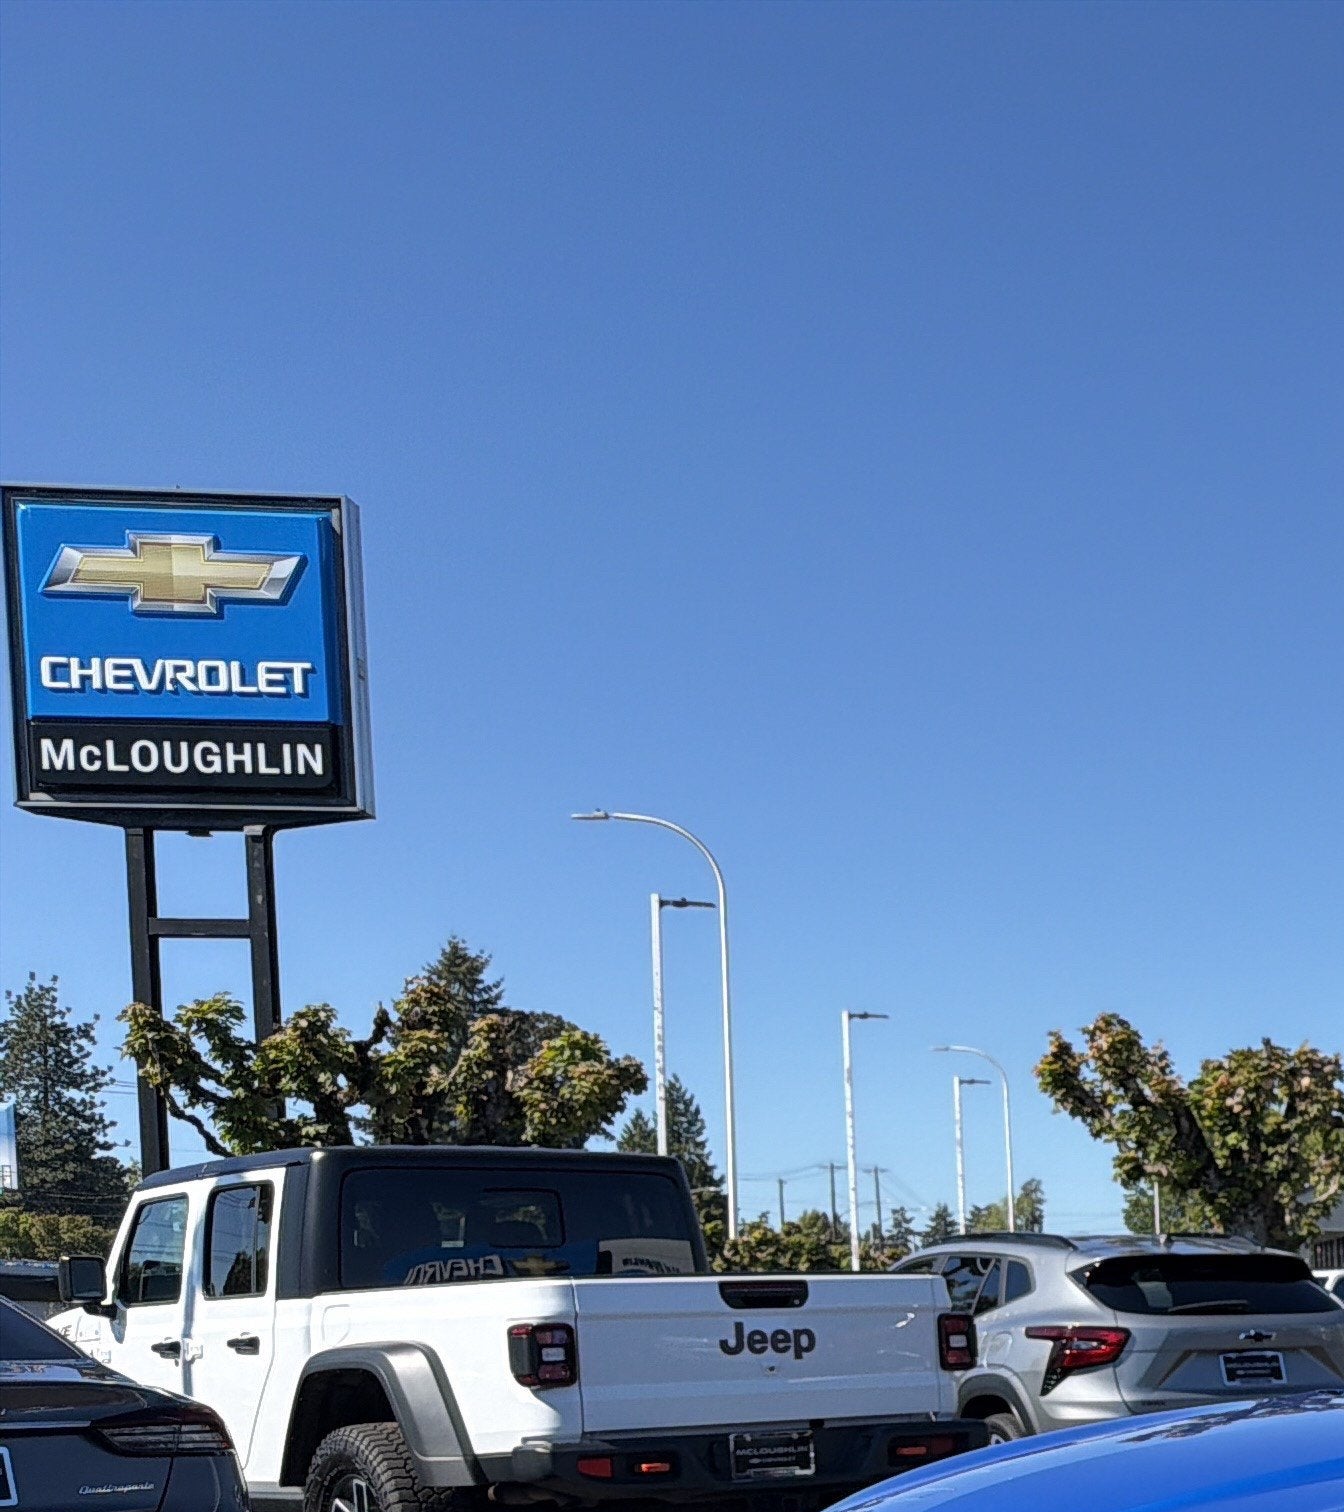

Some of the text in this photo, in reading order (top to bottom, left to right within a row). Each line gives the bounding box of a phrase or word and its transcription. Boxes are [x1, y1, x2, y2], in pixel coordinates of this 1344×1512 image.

[41, 656, 312, 695] CHEVROLET
[40, 738, 325, 776] McLOUGHLIN
[719, 1321, 816, 1360] Jeep
